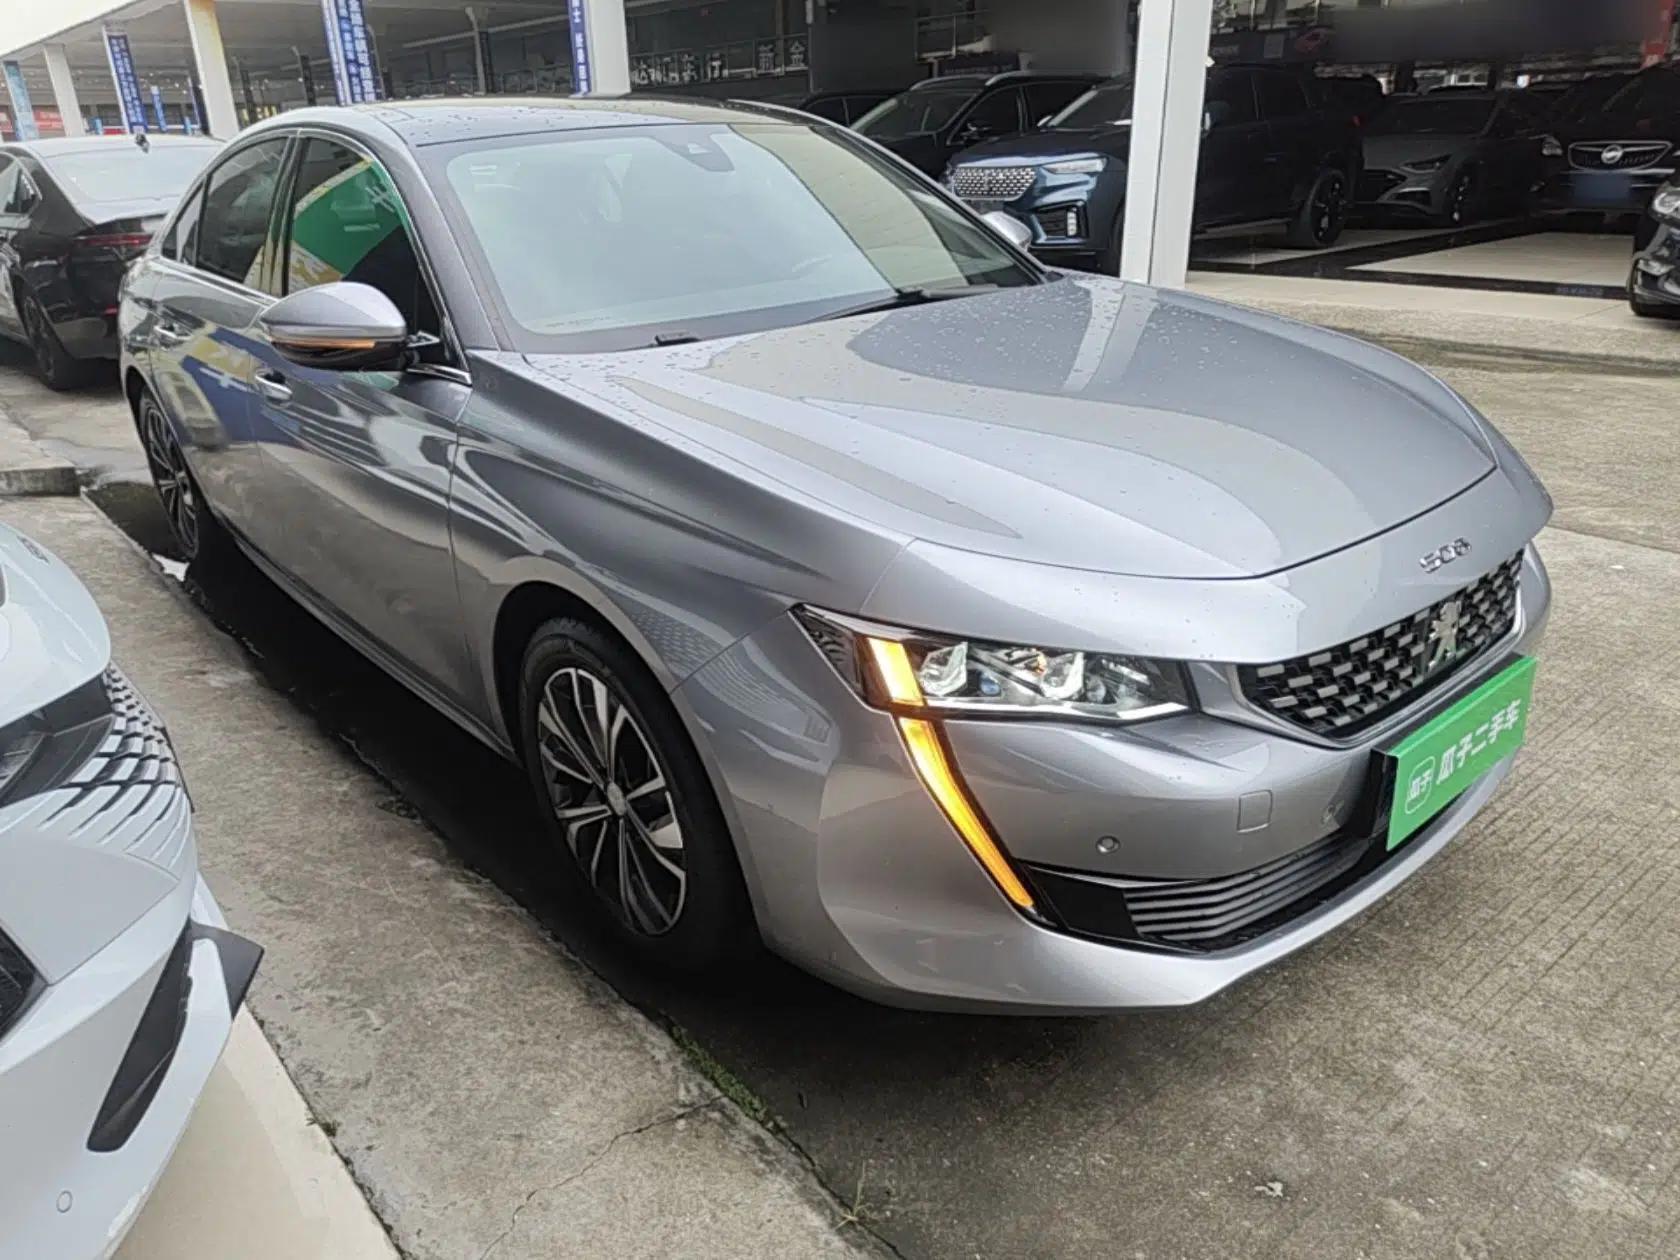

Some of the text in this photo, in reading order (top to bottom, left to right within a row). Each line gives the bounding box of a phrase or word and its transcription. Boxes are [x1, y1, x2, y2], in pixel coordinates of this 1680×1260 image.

[1419, 537, 1471, 574] 508
[1436, 699, 1521, 785] 瓜子二手车
